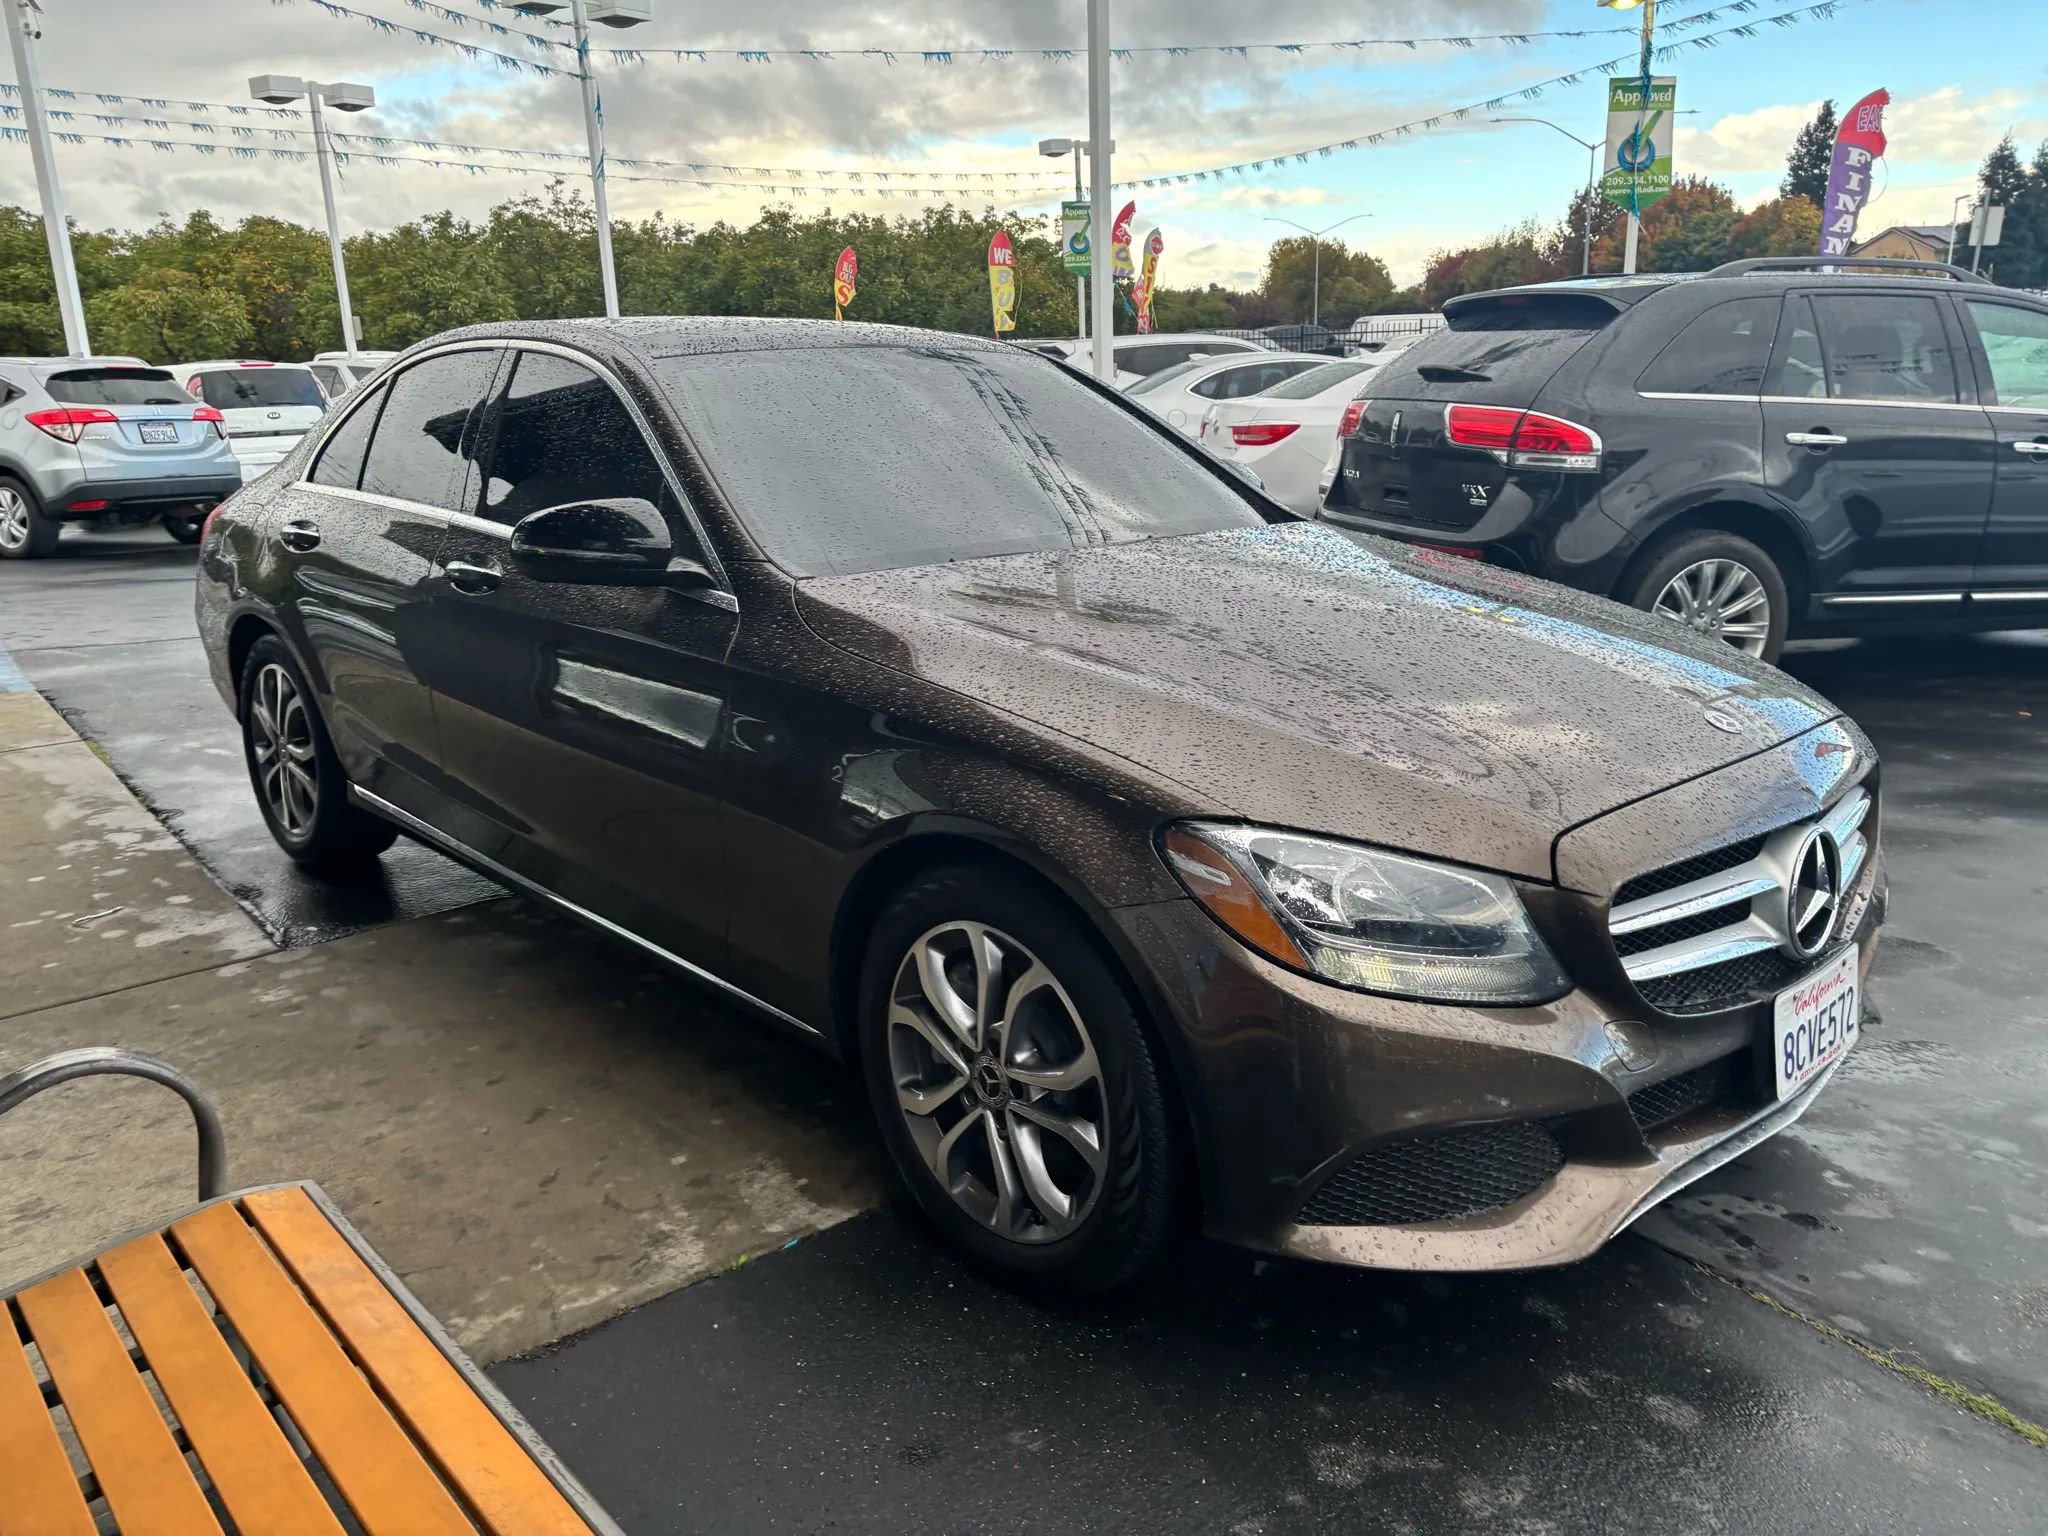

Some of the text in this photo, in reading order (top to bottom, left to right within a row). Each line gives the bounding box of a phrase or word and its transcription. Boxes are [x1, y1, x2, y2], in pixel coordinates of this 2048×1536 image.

[1613, 87, 1673, 107] Appoved
[1604, 186, 1670, 196] ApprovdLodi.com
[993, 247, 1013, 265] WE
[1793, 972, 1846, 1017] California
[1784, 985, 1855, 1080] 8CVE572
[1799, 1043, 1842, 1081] dmv.ca.gov
